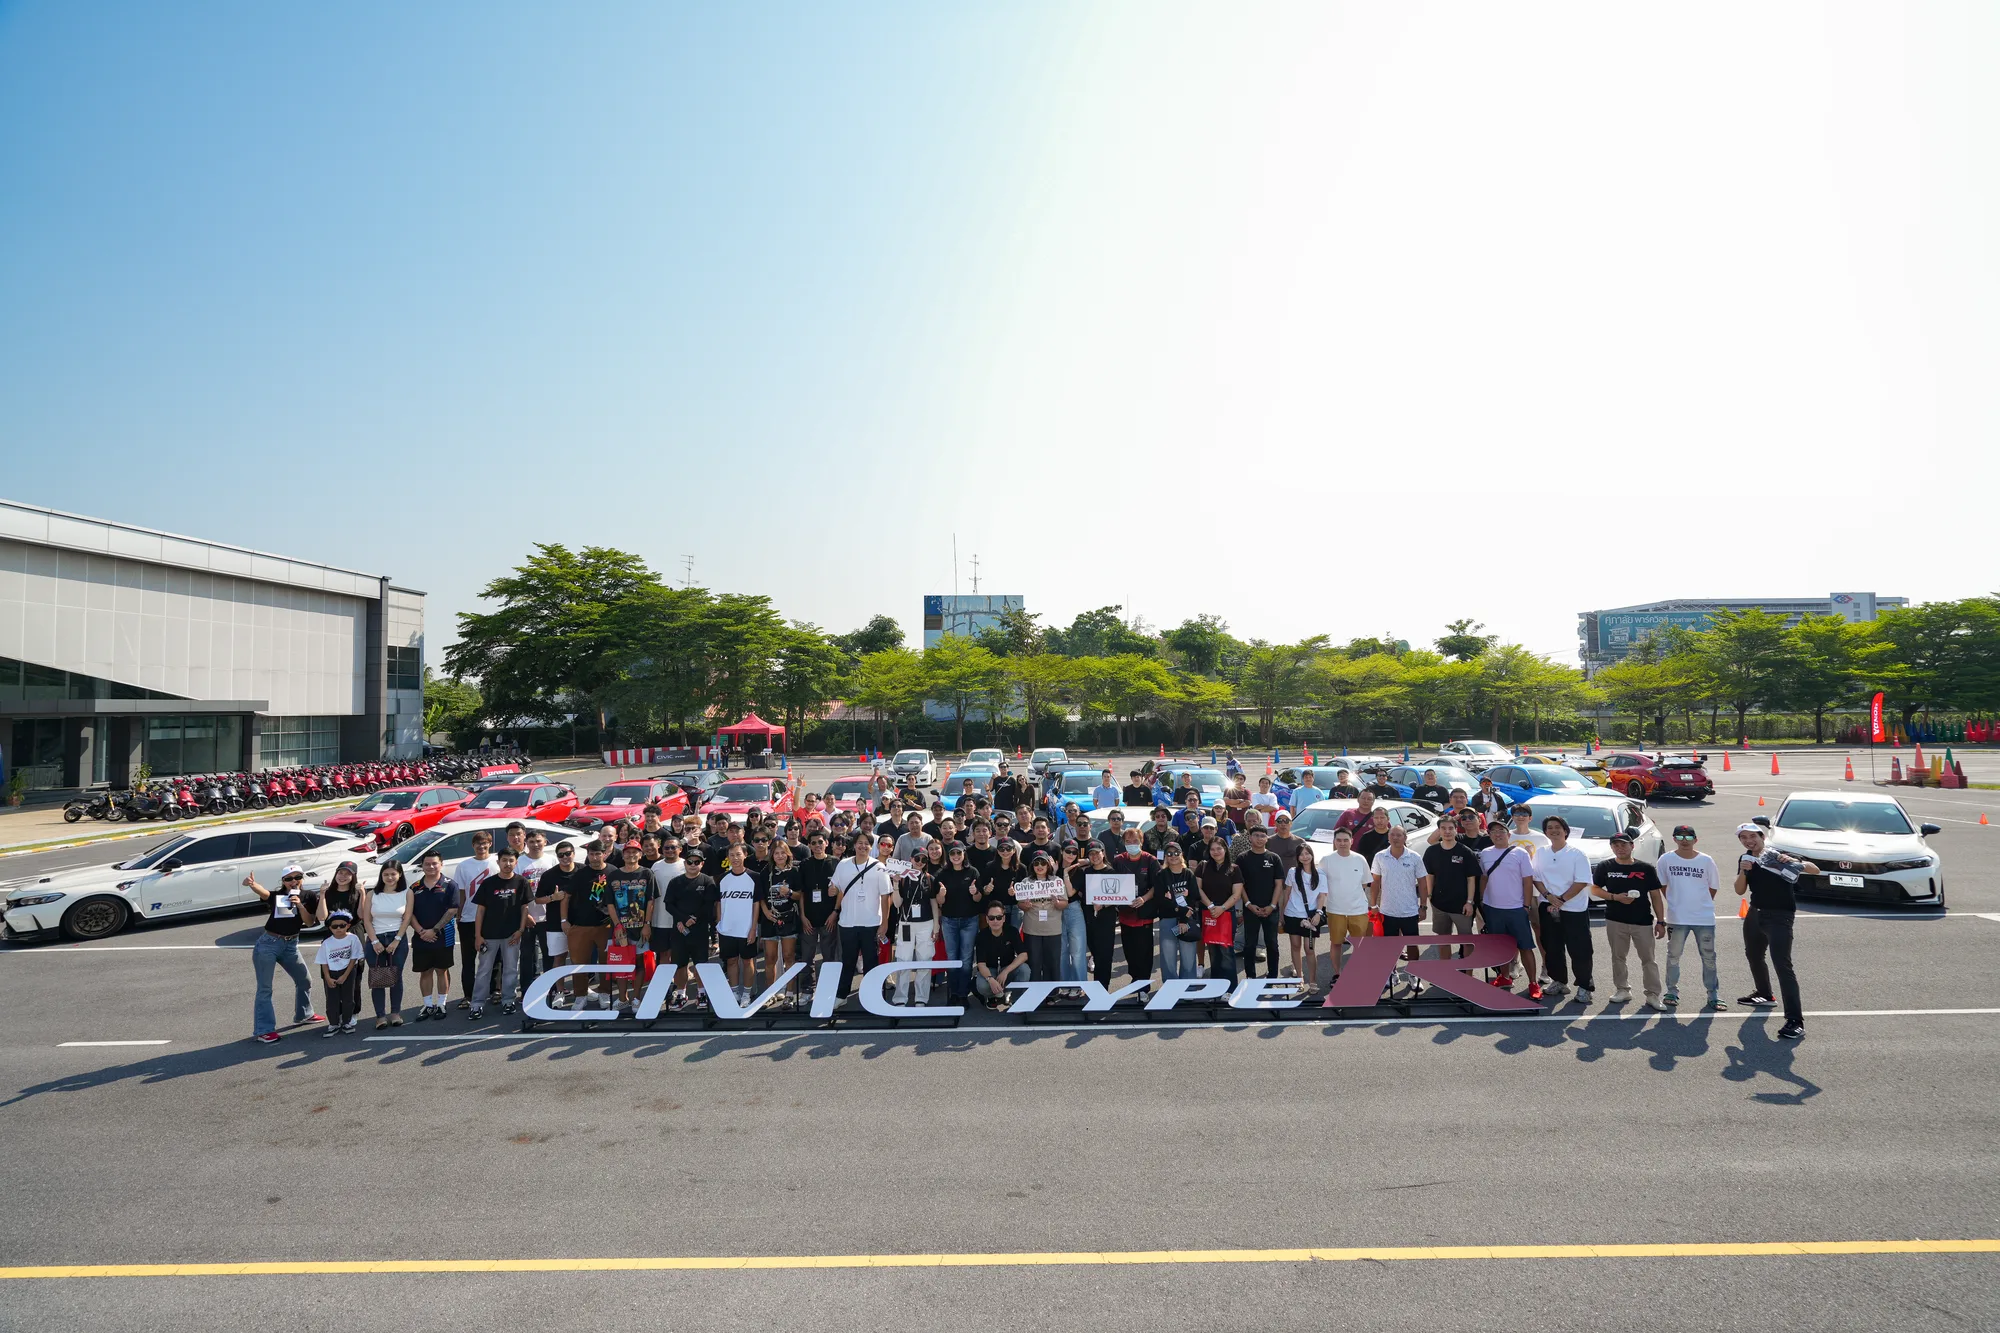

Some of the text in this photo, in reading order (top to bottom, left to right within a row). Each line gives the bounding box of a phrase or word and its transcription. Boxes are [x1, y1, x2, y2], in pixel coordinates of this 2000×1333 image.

[887, 859, 911, 868] CIVIC
[901, 868, 920, 879] R
[1669, 866, 1704, 874] ESSENTIALS
[1627, 871, 1645, 880] R
[1015, 879, 1063, 891] Civic Type R
[522, 933, 1548, 1020] CIVIC TYPE R
